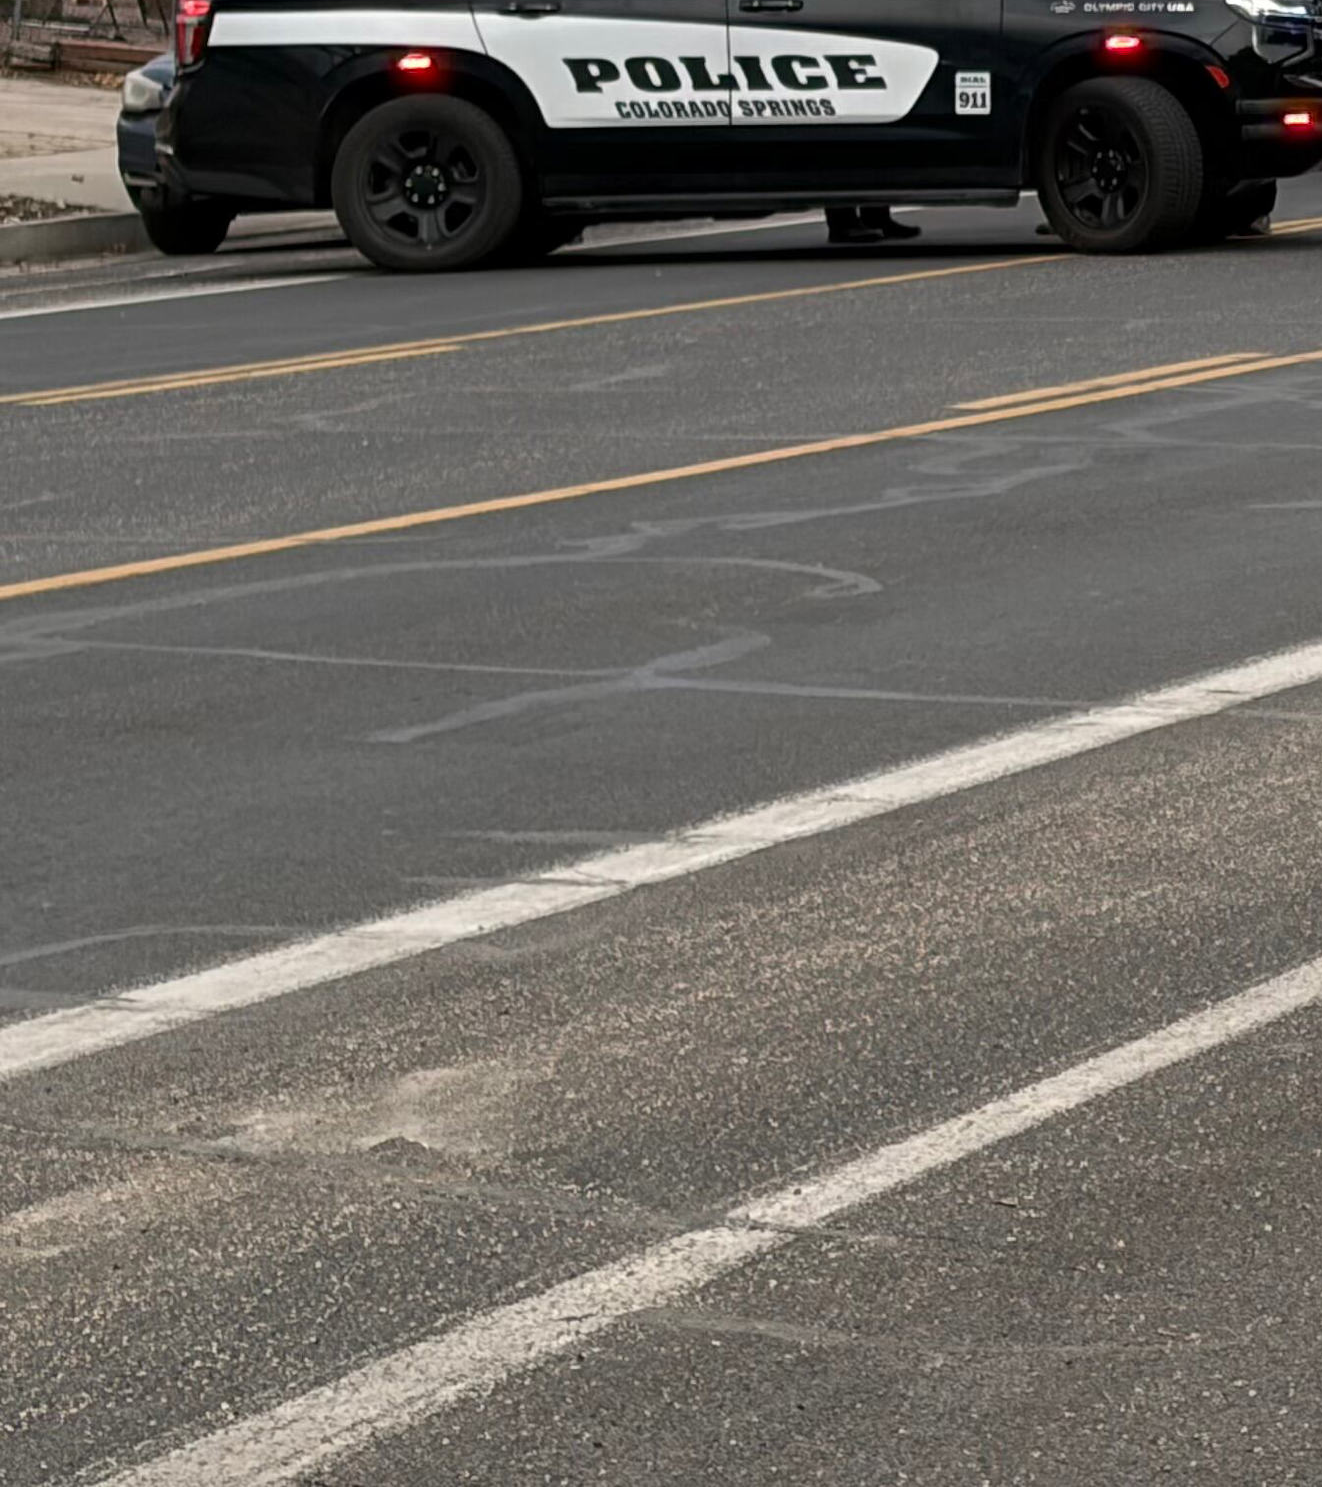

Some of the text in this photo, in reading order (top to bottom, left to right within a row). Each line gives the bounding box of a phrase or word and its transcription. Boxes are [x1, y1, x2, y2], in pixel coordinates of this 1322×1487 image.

[1167, 2, 1195, 13] USA
[562, 54, 888, 93] POLICE
[615, 98, 837, 119] COLORADO SPRINGS
[959, 91, 987, 109] 911
